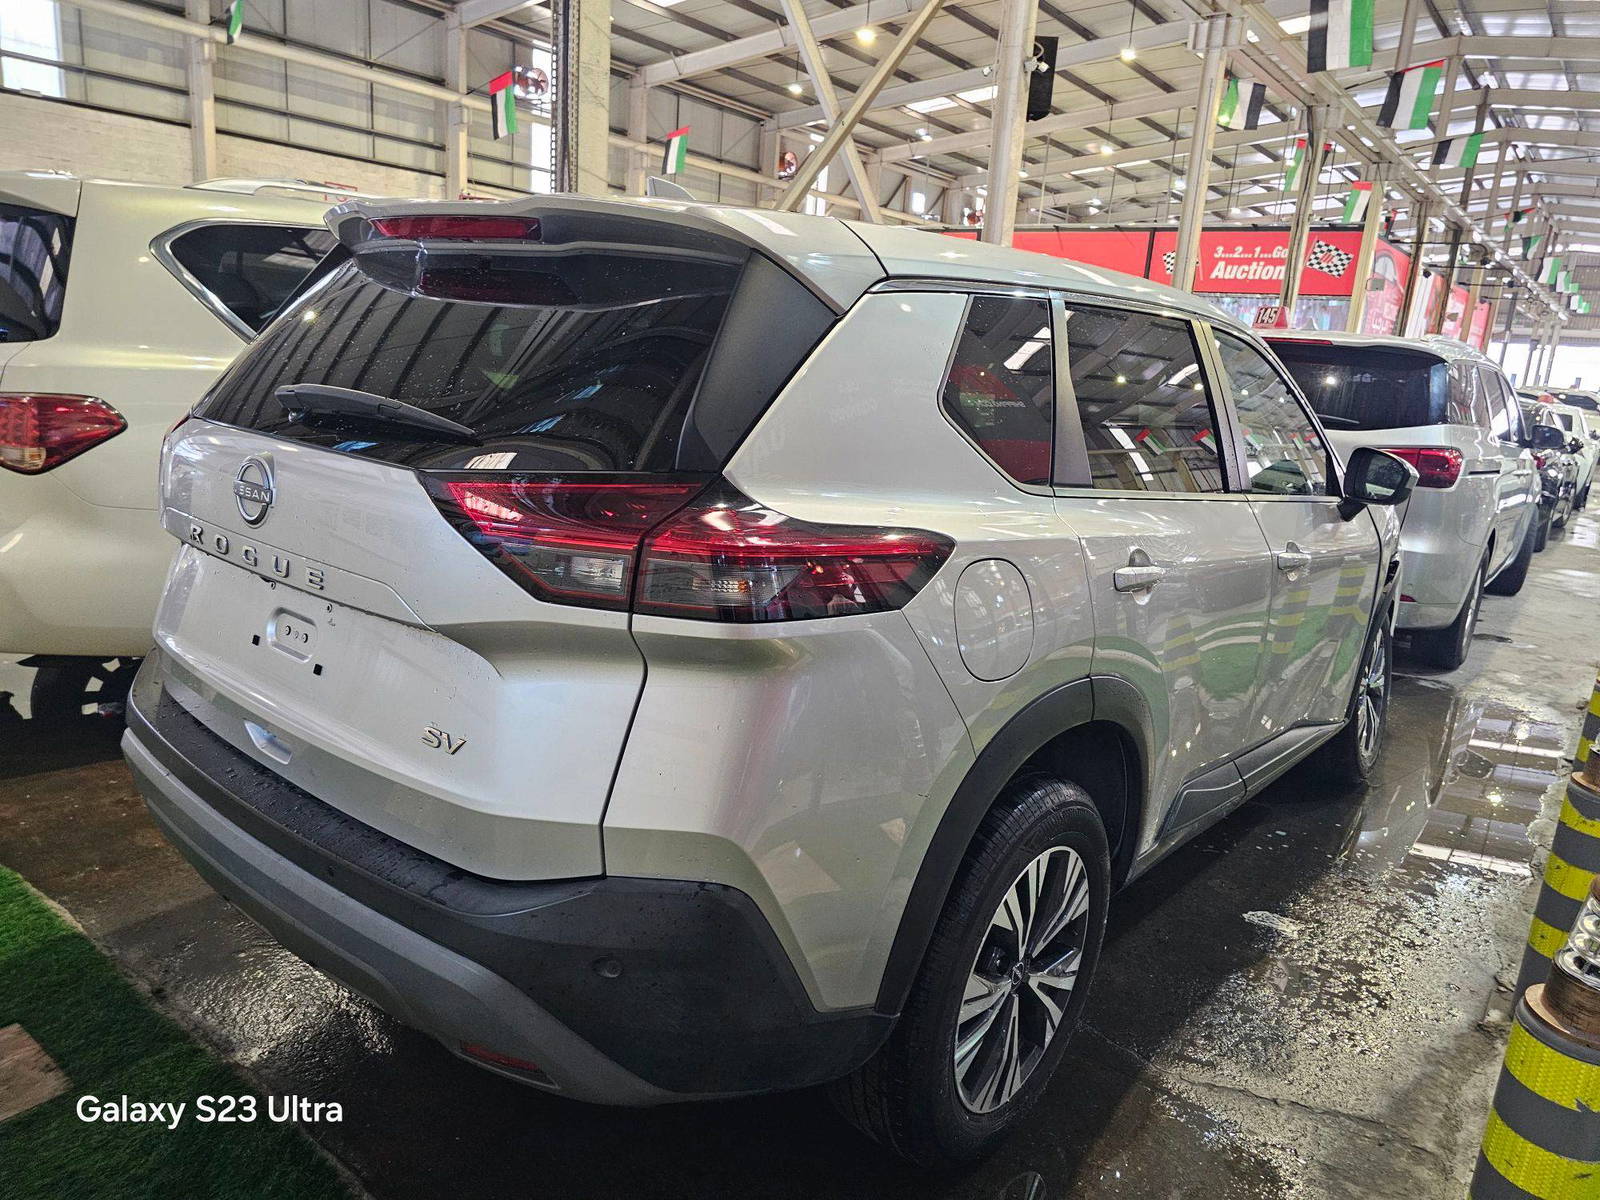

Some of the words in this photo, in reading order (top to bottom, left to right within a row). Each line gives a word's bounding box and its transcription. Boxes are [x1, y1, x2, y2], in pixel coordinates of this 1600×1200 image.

[1210, 261, 1286, 280] Auction
[1255, 307, 1278, 324] 145
[234, 484, 270, 502] SSAN
[190, 524, 325, 590] ROGUE
[421, 725, 467, 755] SV
